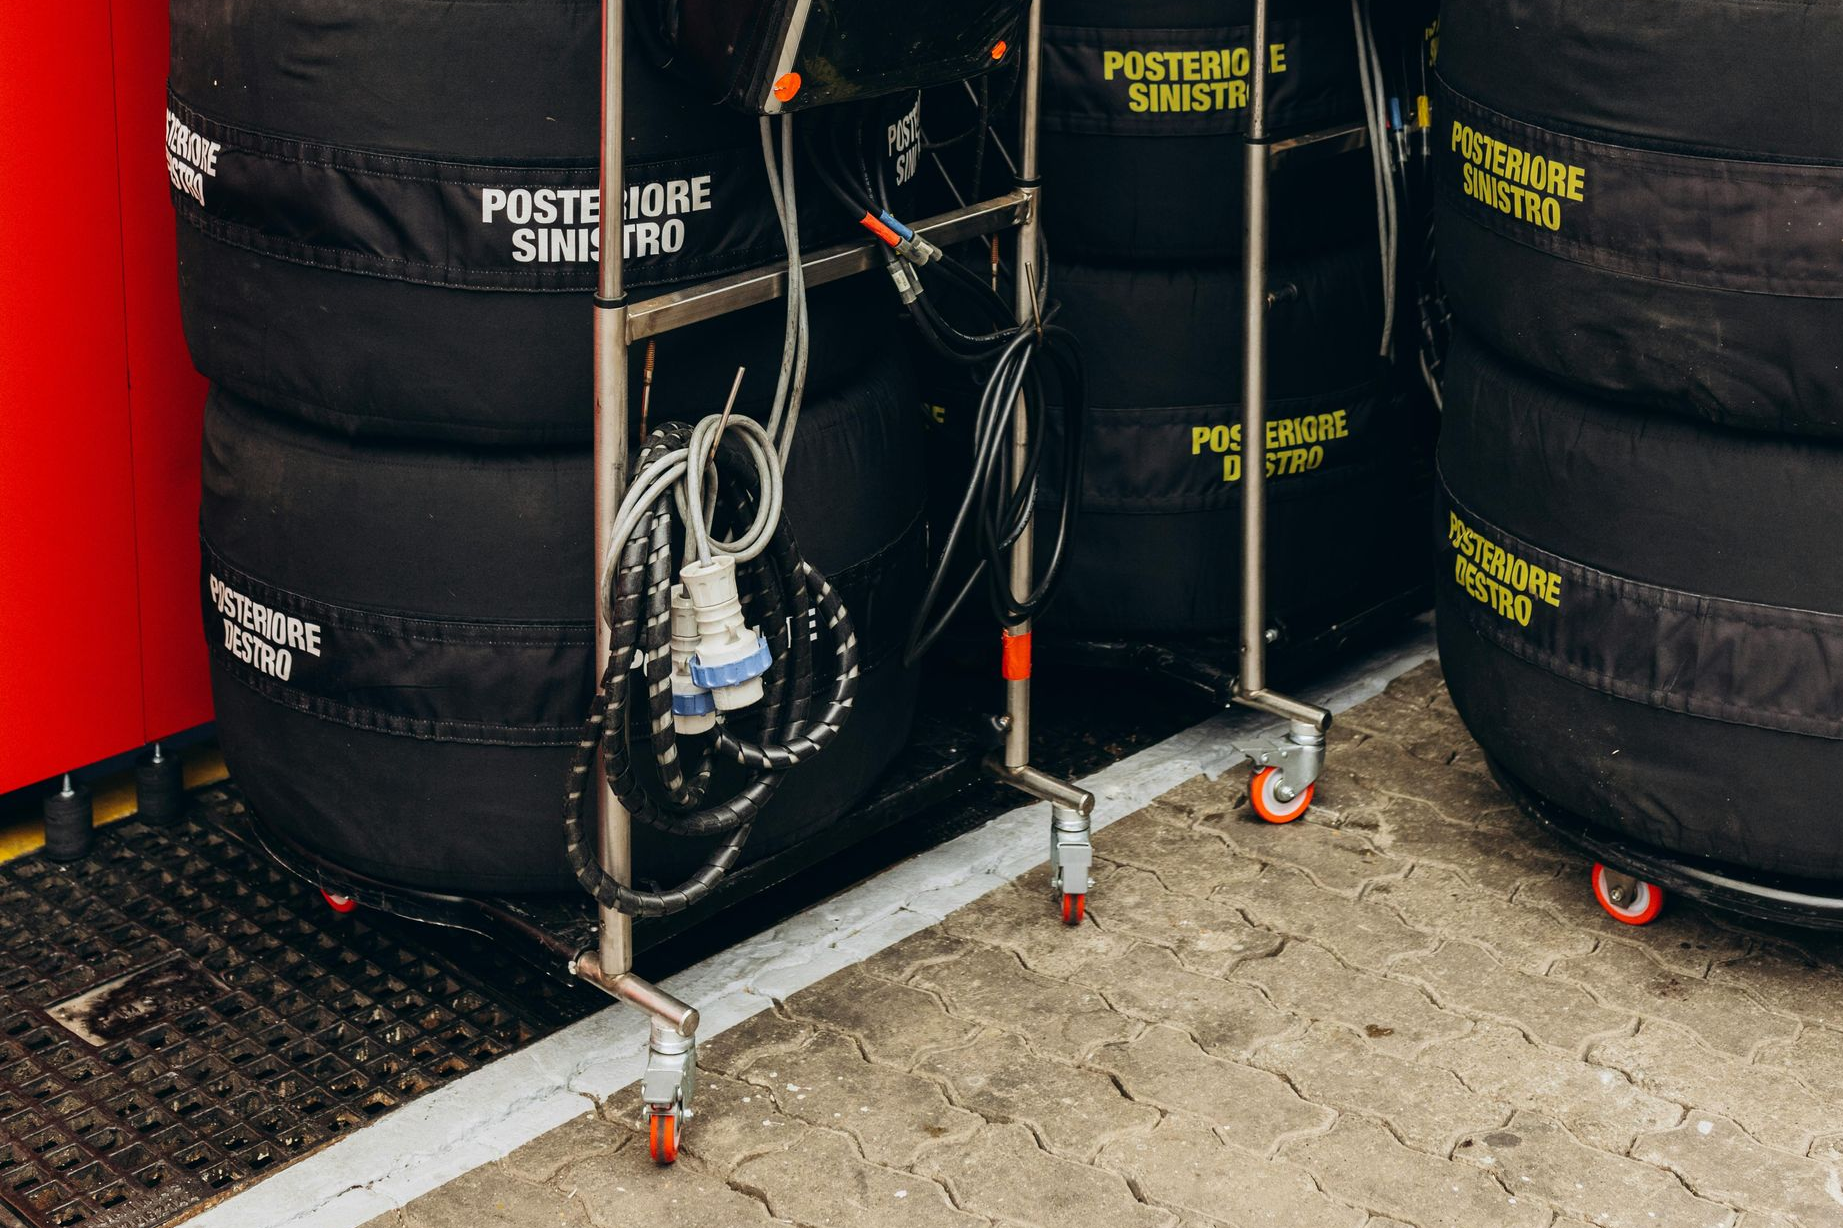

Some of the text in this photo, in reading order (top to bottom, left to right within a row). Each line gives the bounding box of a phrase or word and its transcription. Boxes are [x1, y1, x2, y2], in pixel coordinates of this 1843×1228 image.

[1103, 43, 1287, 82] POSTERIOE
[1128, 79, 1250, 113] SINISTR
[1451, 120, 1586, 203] POSTERIORE
[482, 175, 713, 225] POSTEIORE
[1462, 162, 1561, 232] SINISTRO
[1191, 409, 1349, 456] POSERIORE
[1222, 445, 1325, 483] DSTRO
[1449, 509, 1563, 608] POSTERIORE
[1455, 553, 1533, 627] DESTRO
[209, 572, 322, 658] POSTERIORE
[223, 618, 293, 682] DESTRO
